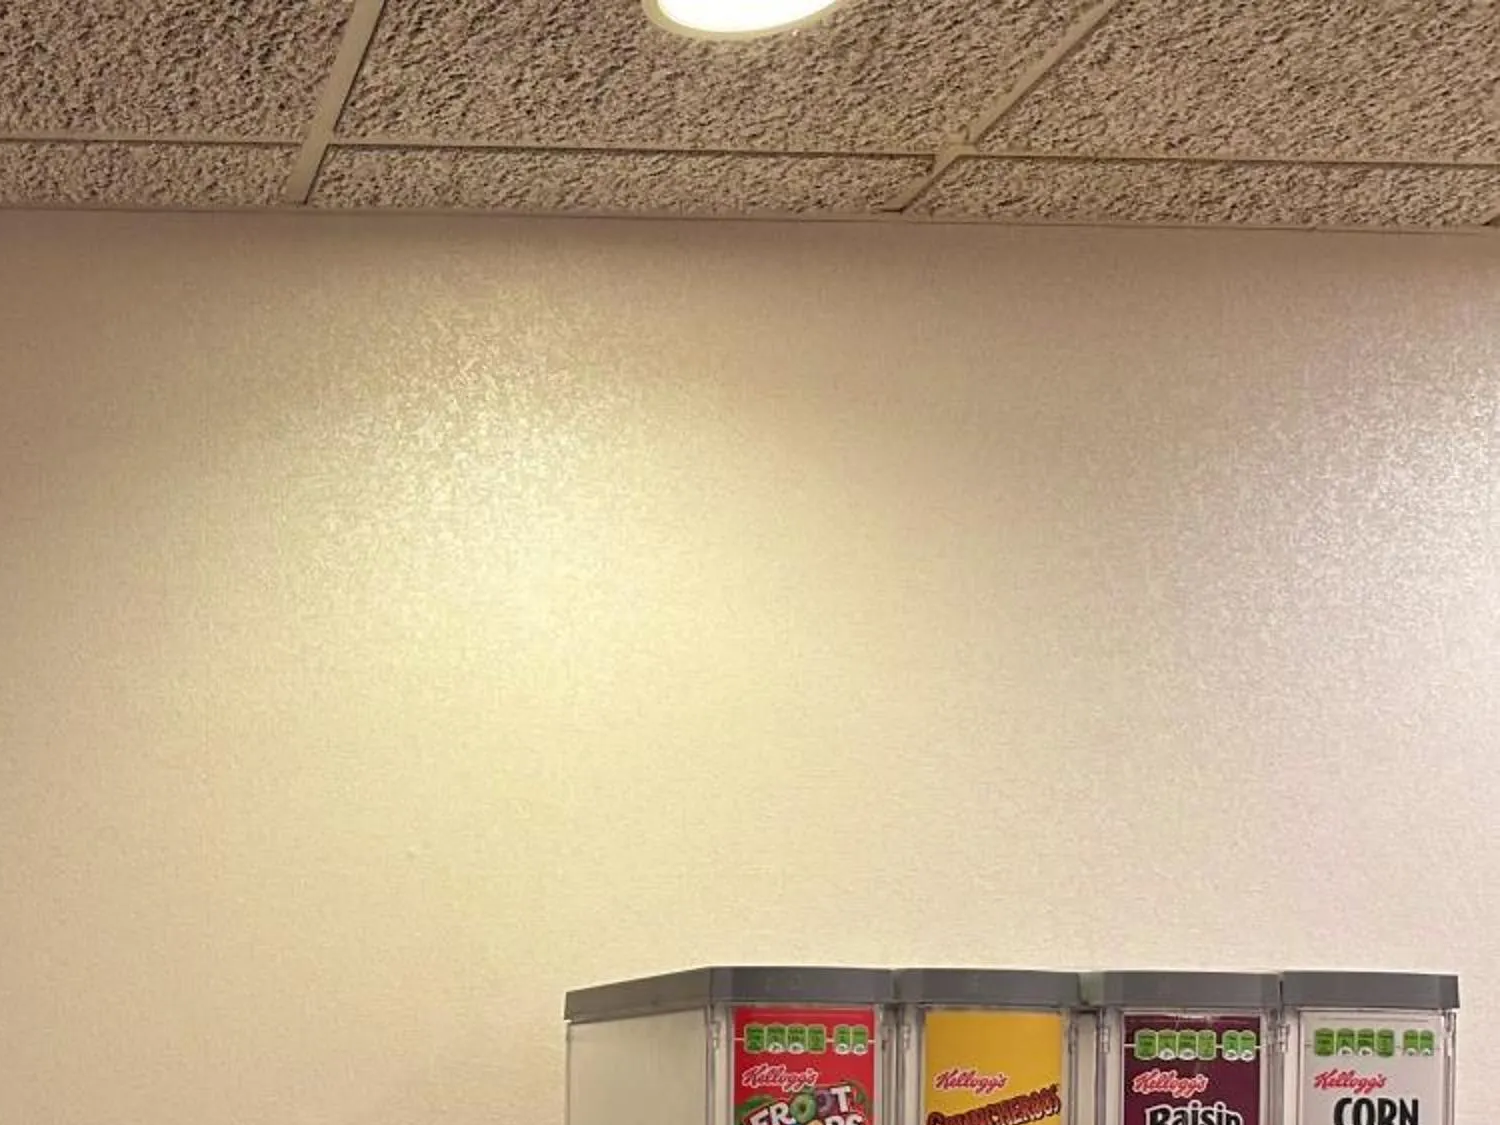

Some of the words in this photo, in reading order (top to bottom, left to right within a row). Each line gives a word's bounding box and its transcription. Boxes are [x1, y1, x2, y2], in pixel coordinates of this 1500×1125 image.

[742, 1063, 819, 1092] Kellogg's
[934, 1068, 1008, 1094] Kellogg's
[1132, 1069, 1208, 1097] Kellogg's
[1314, 1069, 1387, 1094] Kellogg's
